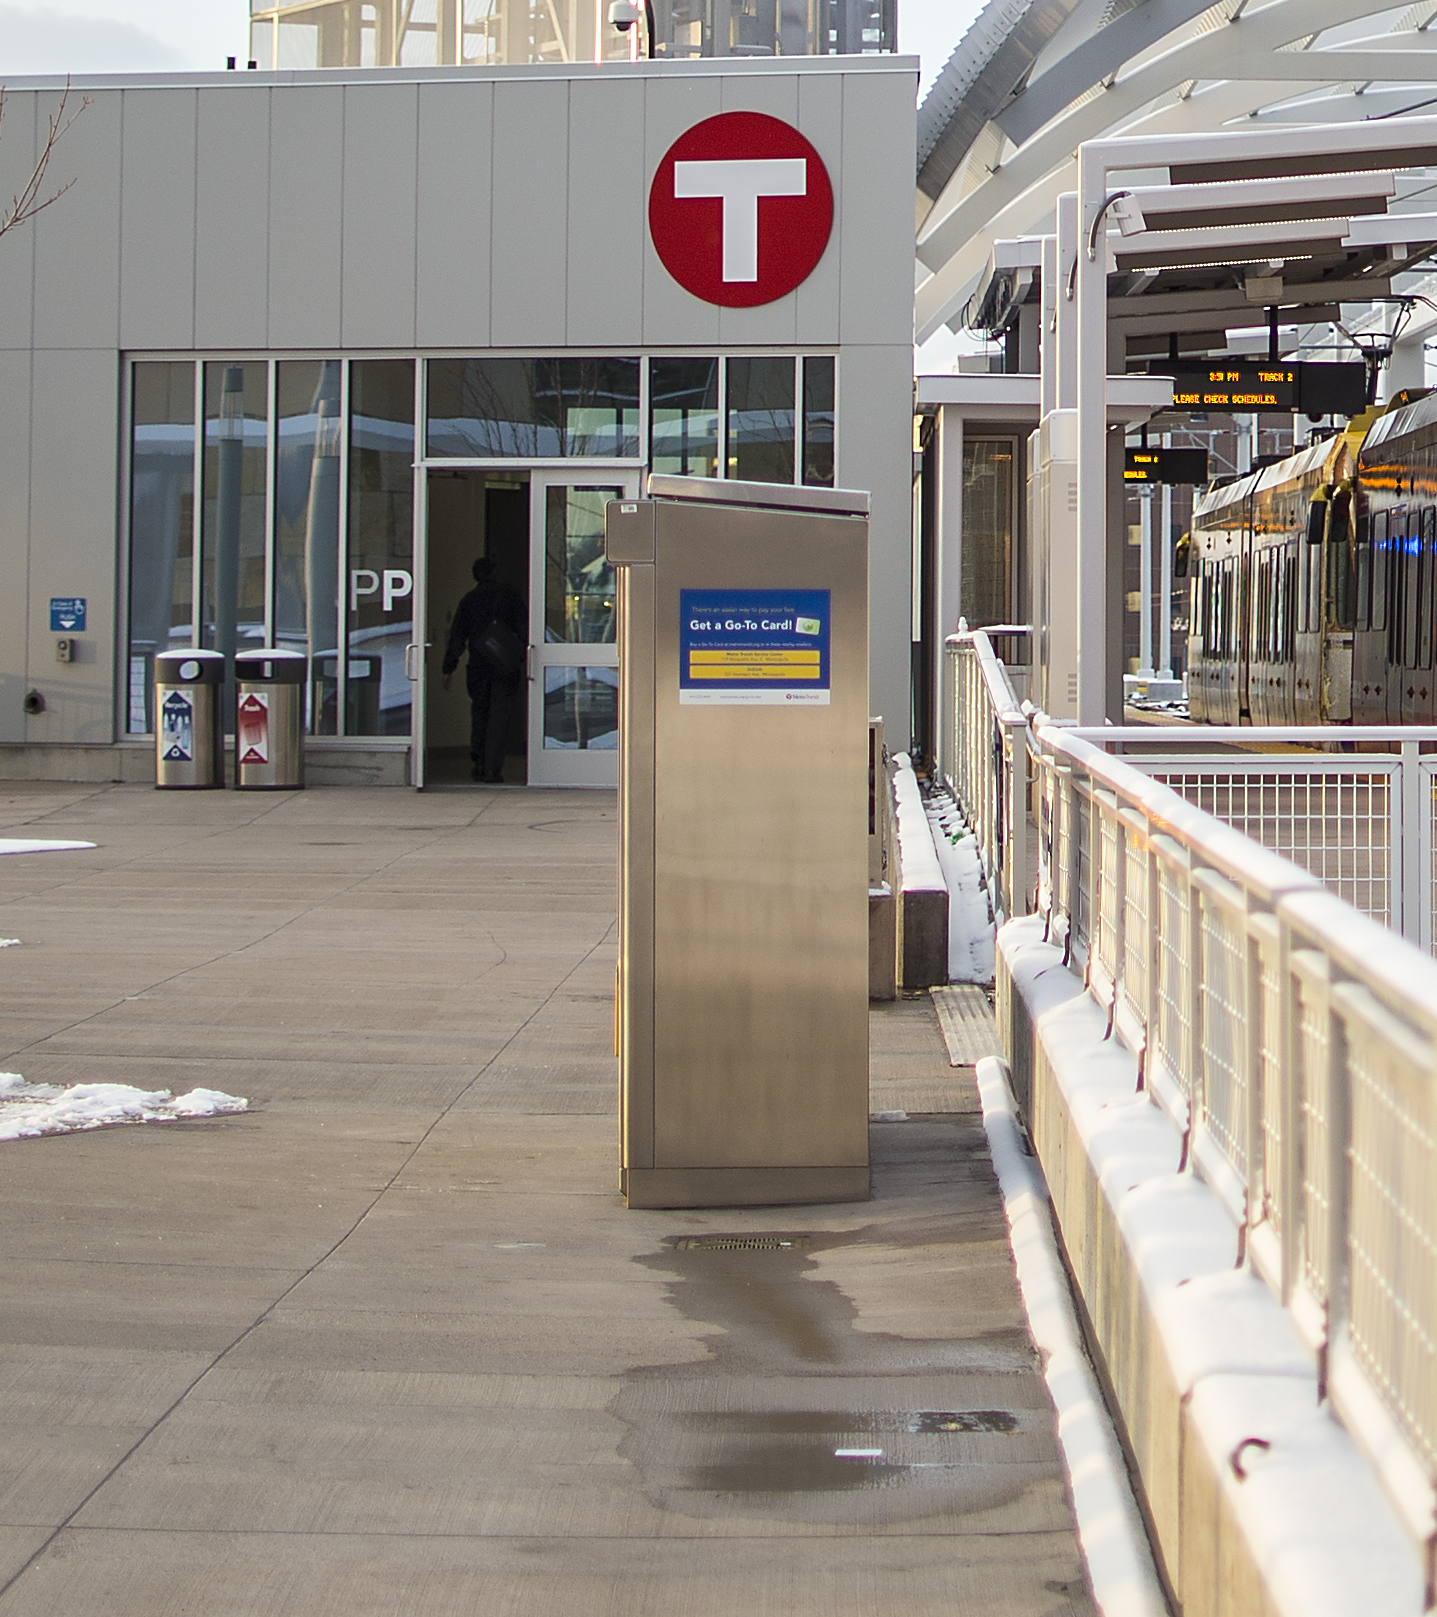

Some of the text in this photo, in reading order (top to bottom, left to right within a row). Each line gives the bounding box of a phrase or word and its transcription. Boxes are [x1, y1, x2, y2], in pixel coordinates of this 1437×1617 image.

[674, 158, 807, 282] T
[1227, 372, 1240, 382] PM
[1258, 372, 1284, 382] TRACK
[1287, 372, 1294, 382] 2
[1203, 393, 1229, 404] CHECK
[690, 619, 792, 631] Get a Go-To Card!
